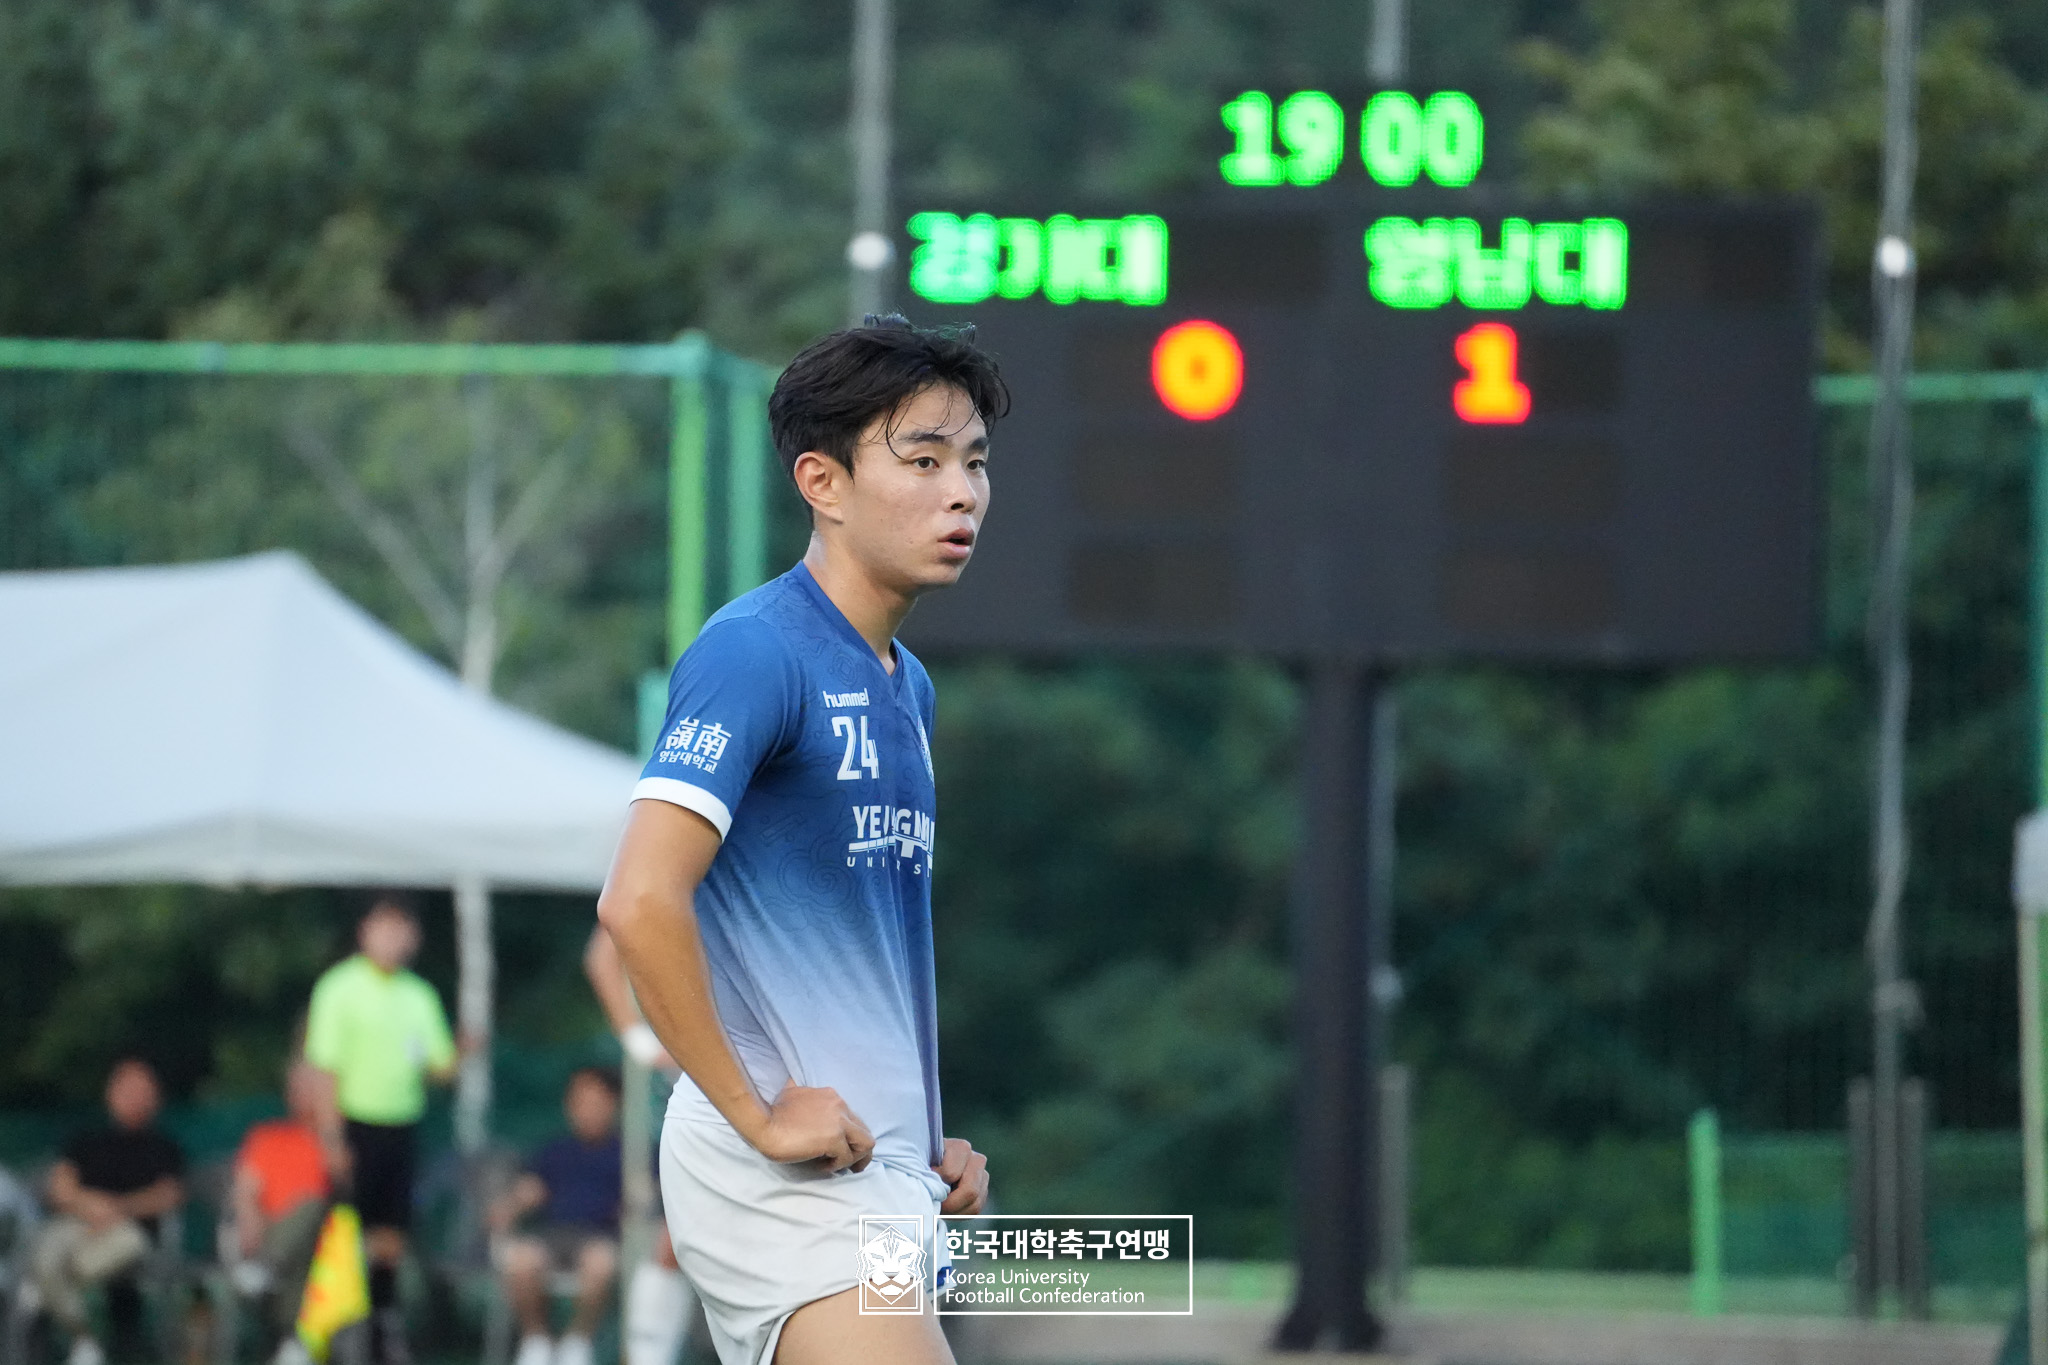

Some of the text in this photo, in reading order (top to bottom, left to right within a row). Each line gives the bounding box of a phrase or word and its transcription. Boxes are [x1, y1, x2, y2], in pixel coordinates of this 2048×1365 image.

[1364, 216, 1629, 310] 영남대
[1150, 320, 1244, 422] 0
[1452, 322, 1532, 424] 1
[823, 688, 869, 709] hummel
[659, 751, 718, 774] 영남대학교
[665, 716, 732, 760] 嶺南
[831, 715, 880, 781] 24
